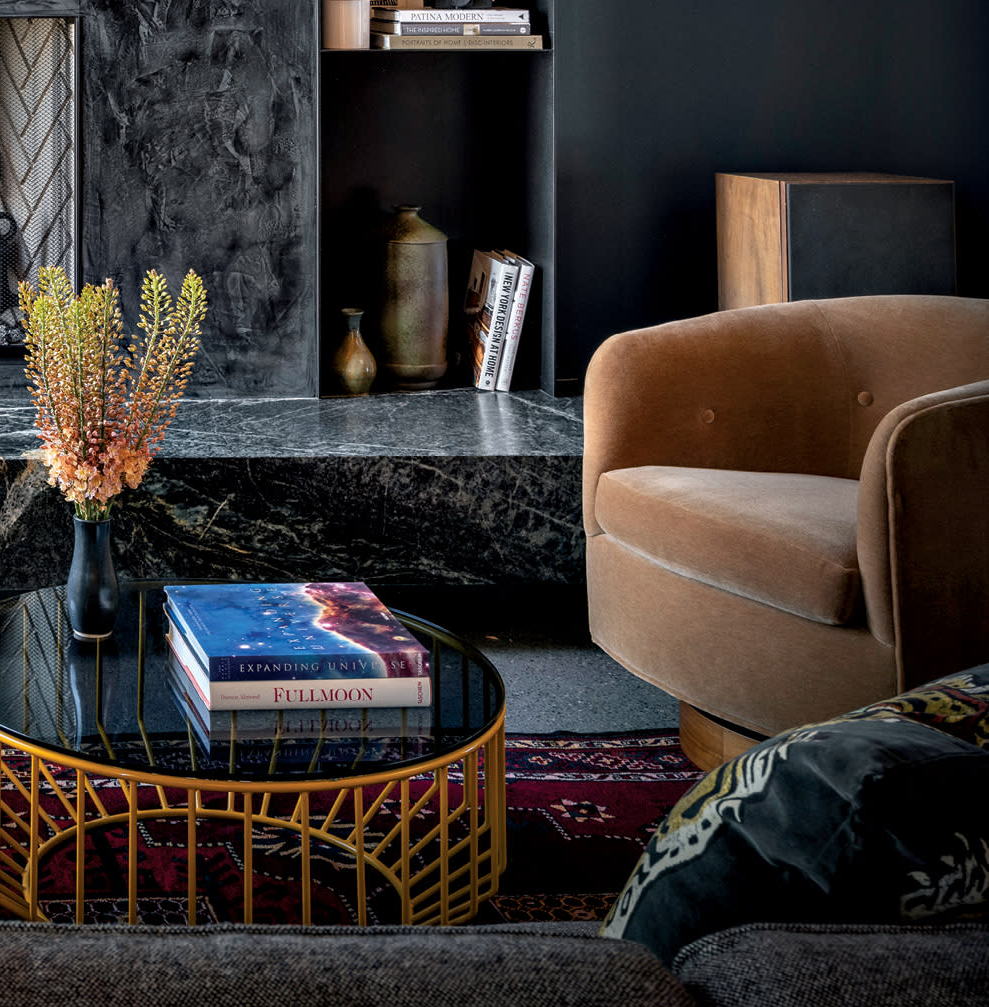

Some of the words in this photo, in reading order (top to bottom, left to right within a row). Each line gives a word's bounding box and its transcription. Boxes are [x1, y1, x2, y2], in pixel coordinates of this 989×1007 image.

[411, 12, 442, 21] PATINA
[444, 12, 484, 21] MODERN
[518, 273, 530, 298] NATE
[499, 294, 510, 315] YORK
[492, 315, 506, 344] DESIGN
[511, 303, 524, 340] BERKUS
[490, 343, 499, 355] AT
[485, 355, 497, 378] HOME
[240, 662, 320, 673] EXPANDING
[273, 687, 373, 703] FULLMOON
